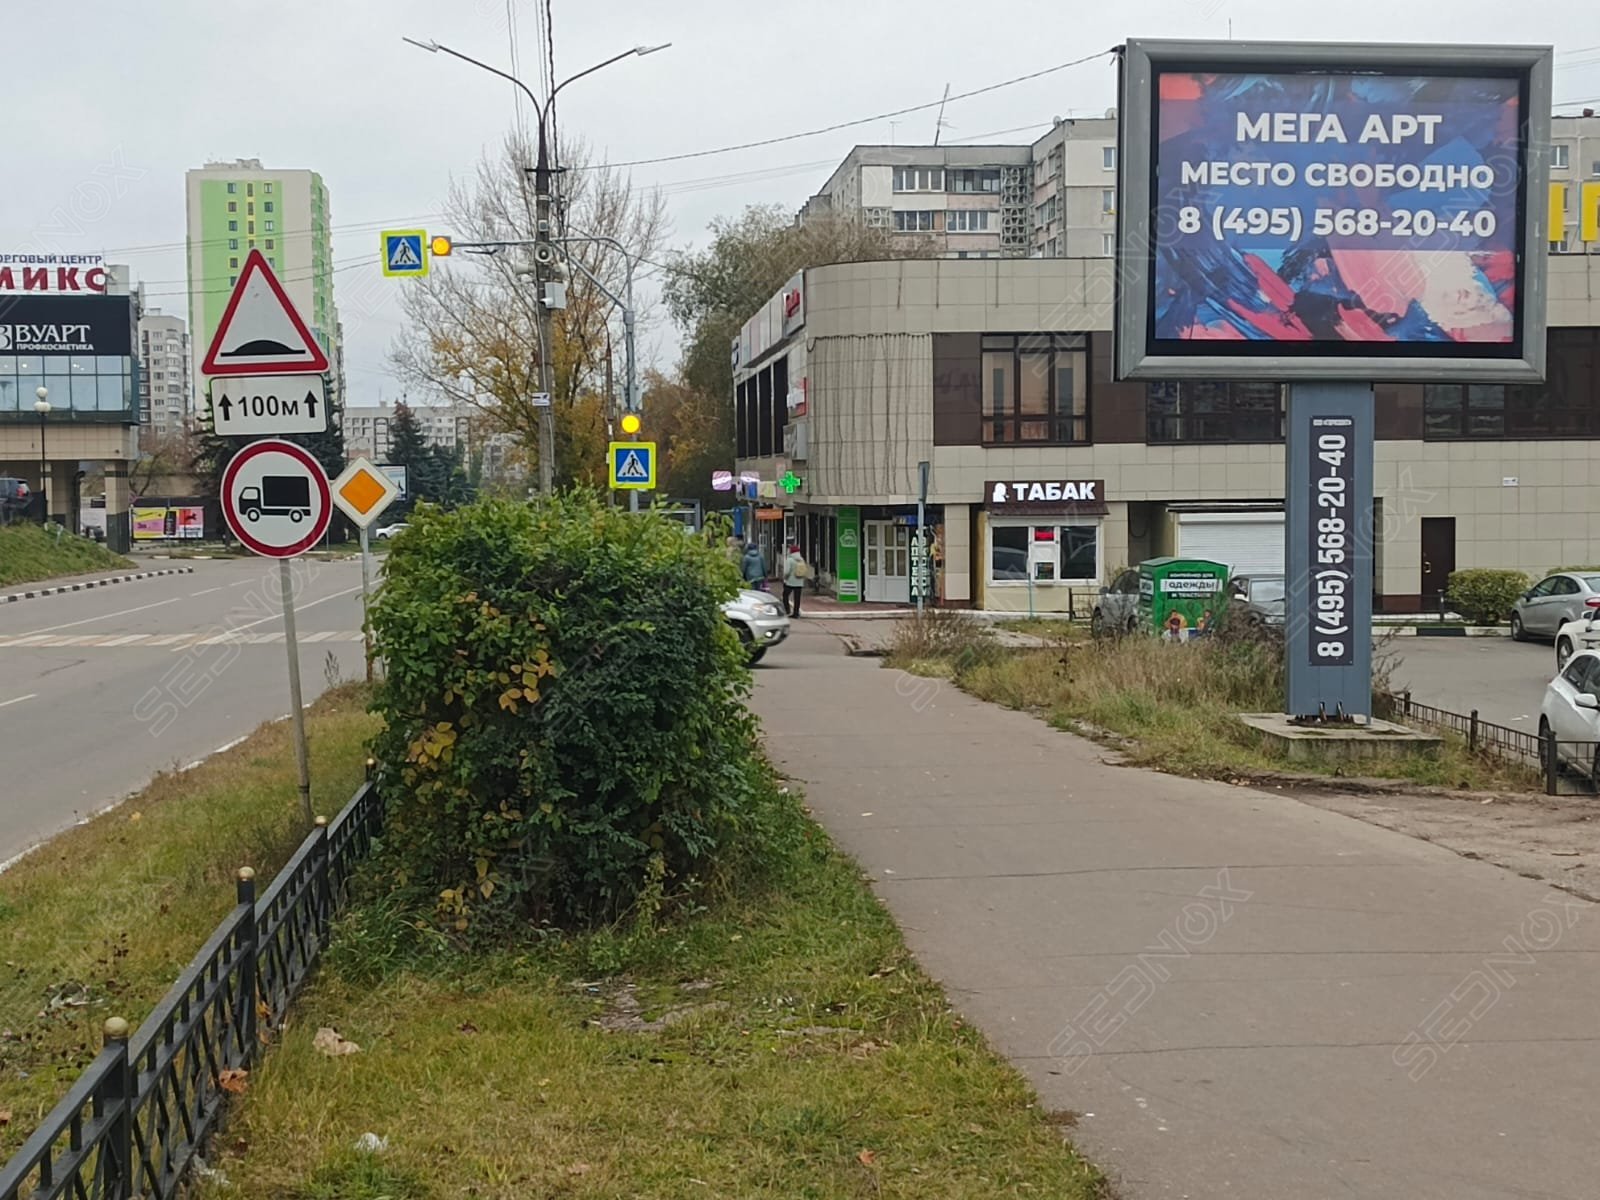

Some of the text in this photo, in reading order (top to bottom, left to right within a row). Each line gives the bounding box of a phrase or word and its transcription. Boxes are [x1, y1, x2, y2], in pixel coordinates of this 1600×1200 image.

[1235, 112, 1442, 144] МЕГА АРТ
[1181, 161, 1494, 192] МЕСТО СВОБОДНО
[1178, 206, 1496, 241] 8 (495) 568-20-40
[60, 255, 102, 265] ЦЕНТР
[15, 324, 91, 343] ВУАРТ
[16, 343, 94, 351] ПРОФКОСМЕТИКА
[238, 395, 299, 417] 100м
[1012, 482, 1096, 501] ТАБАК
[1317, 433, 1347, 564] 568-20-40
[1168, 581, 1215, 589] одежды
[1315, 569, 1349, 635] (495)
[1317, 641, 1345, 657] 8
